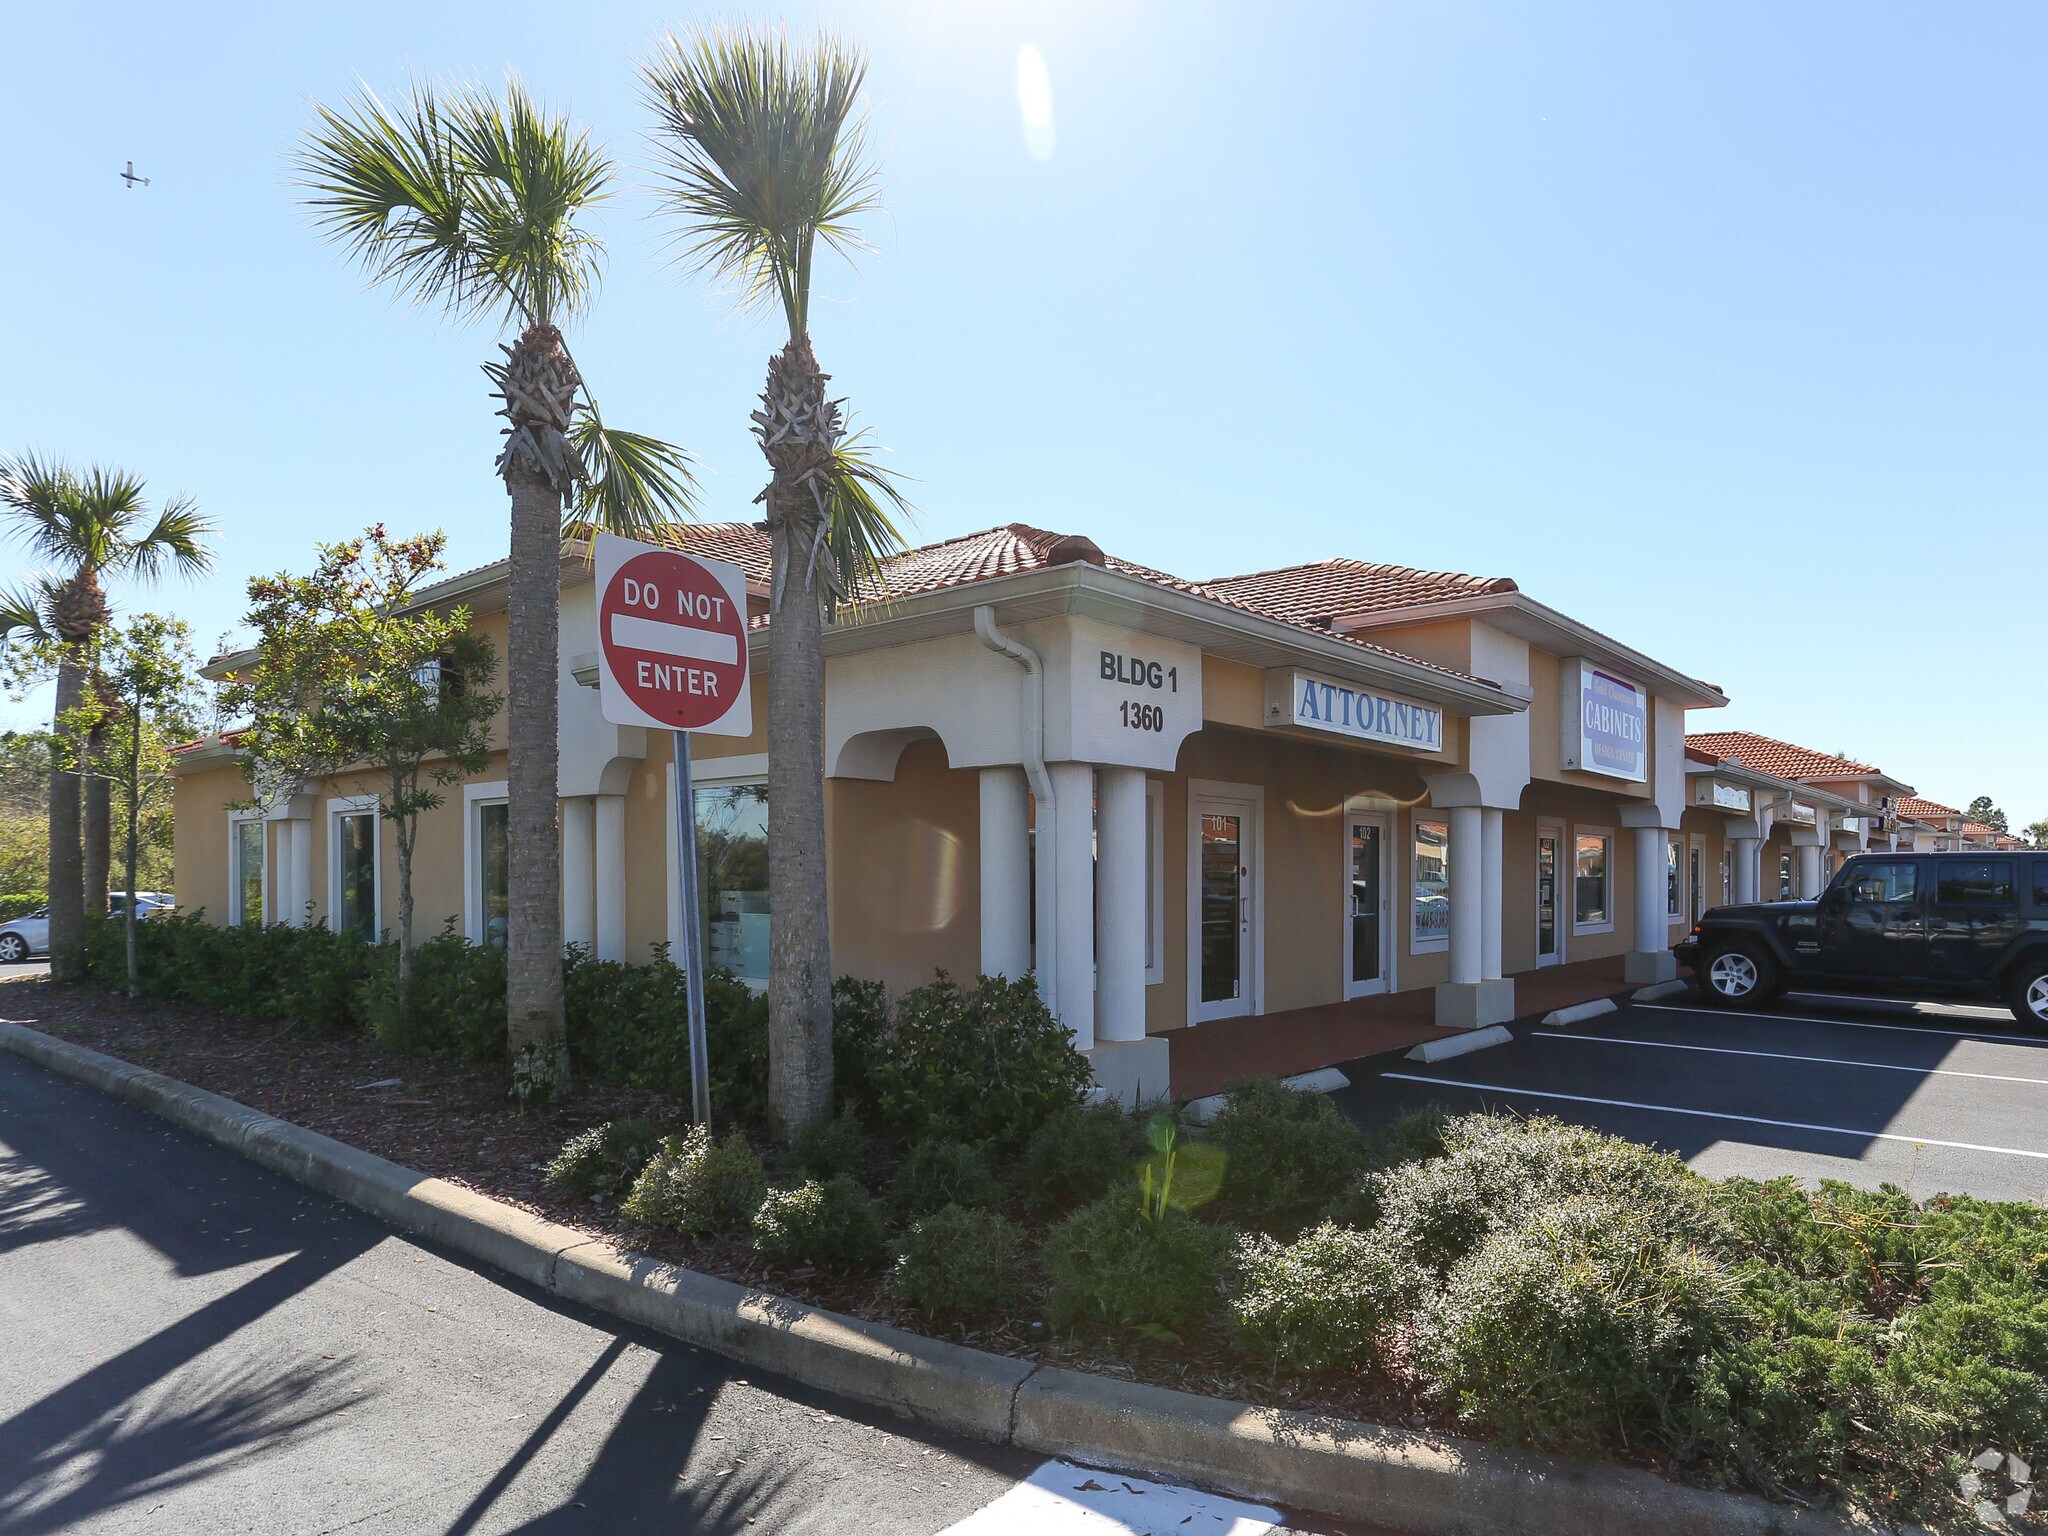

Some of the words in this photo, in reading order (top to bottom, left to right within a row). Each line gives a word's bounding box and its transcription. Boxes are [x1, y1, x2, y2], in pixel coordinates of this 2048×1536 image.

[623, 577, 661, 610] DO
[677, 589, 725, 623] NOT
[637, 660, 719, 698] ENTER
[1100, 650, 1163, 690] BLDG
[1168, 666, 1178, 693] 1
[1119, 700, 1164, 733] 1360
[1298, 679, 1439, 744] ATTORNEY
[1585, 700, 1641, 743] CABINETS
[1210, 815, 1227, 831] 101
[1359, 826, 1371, 840] 102
